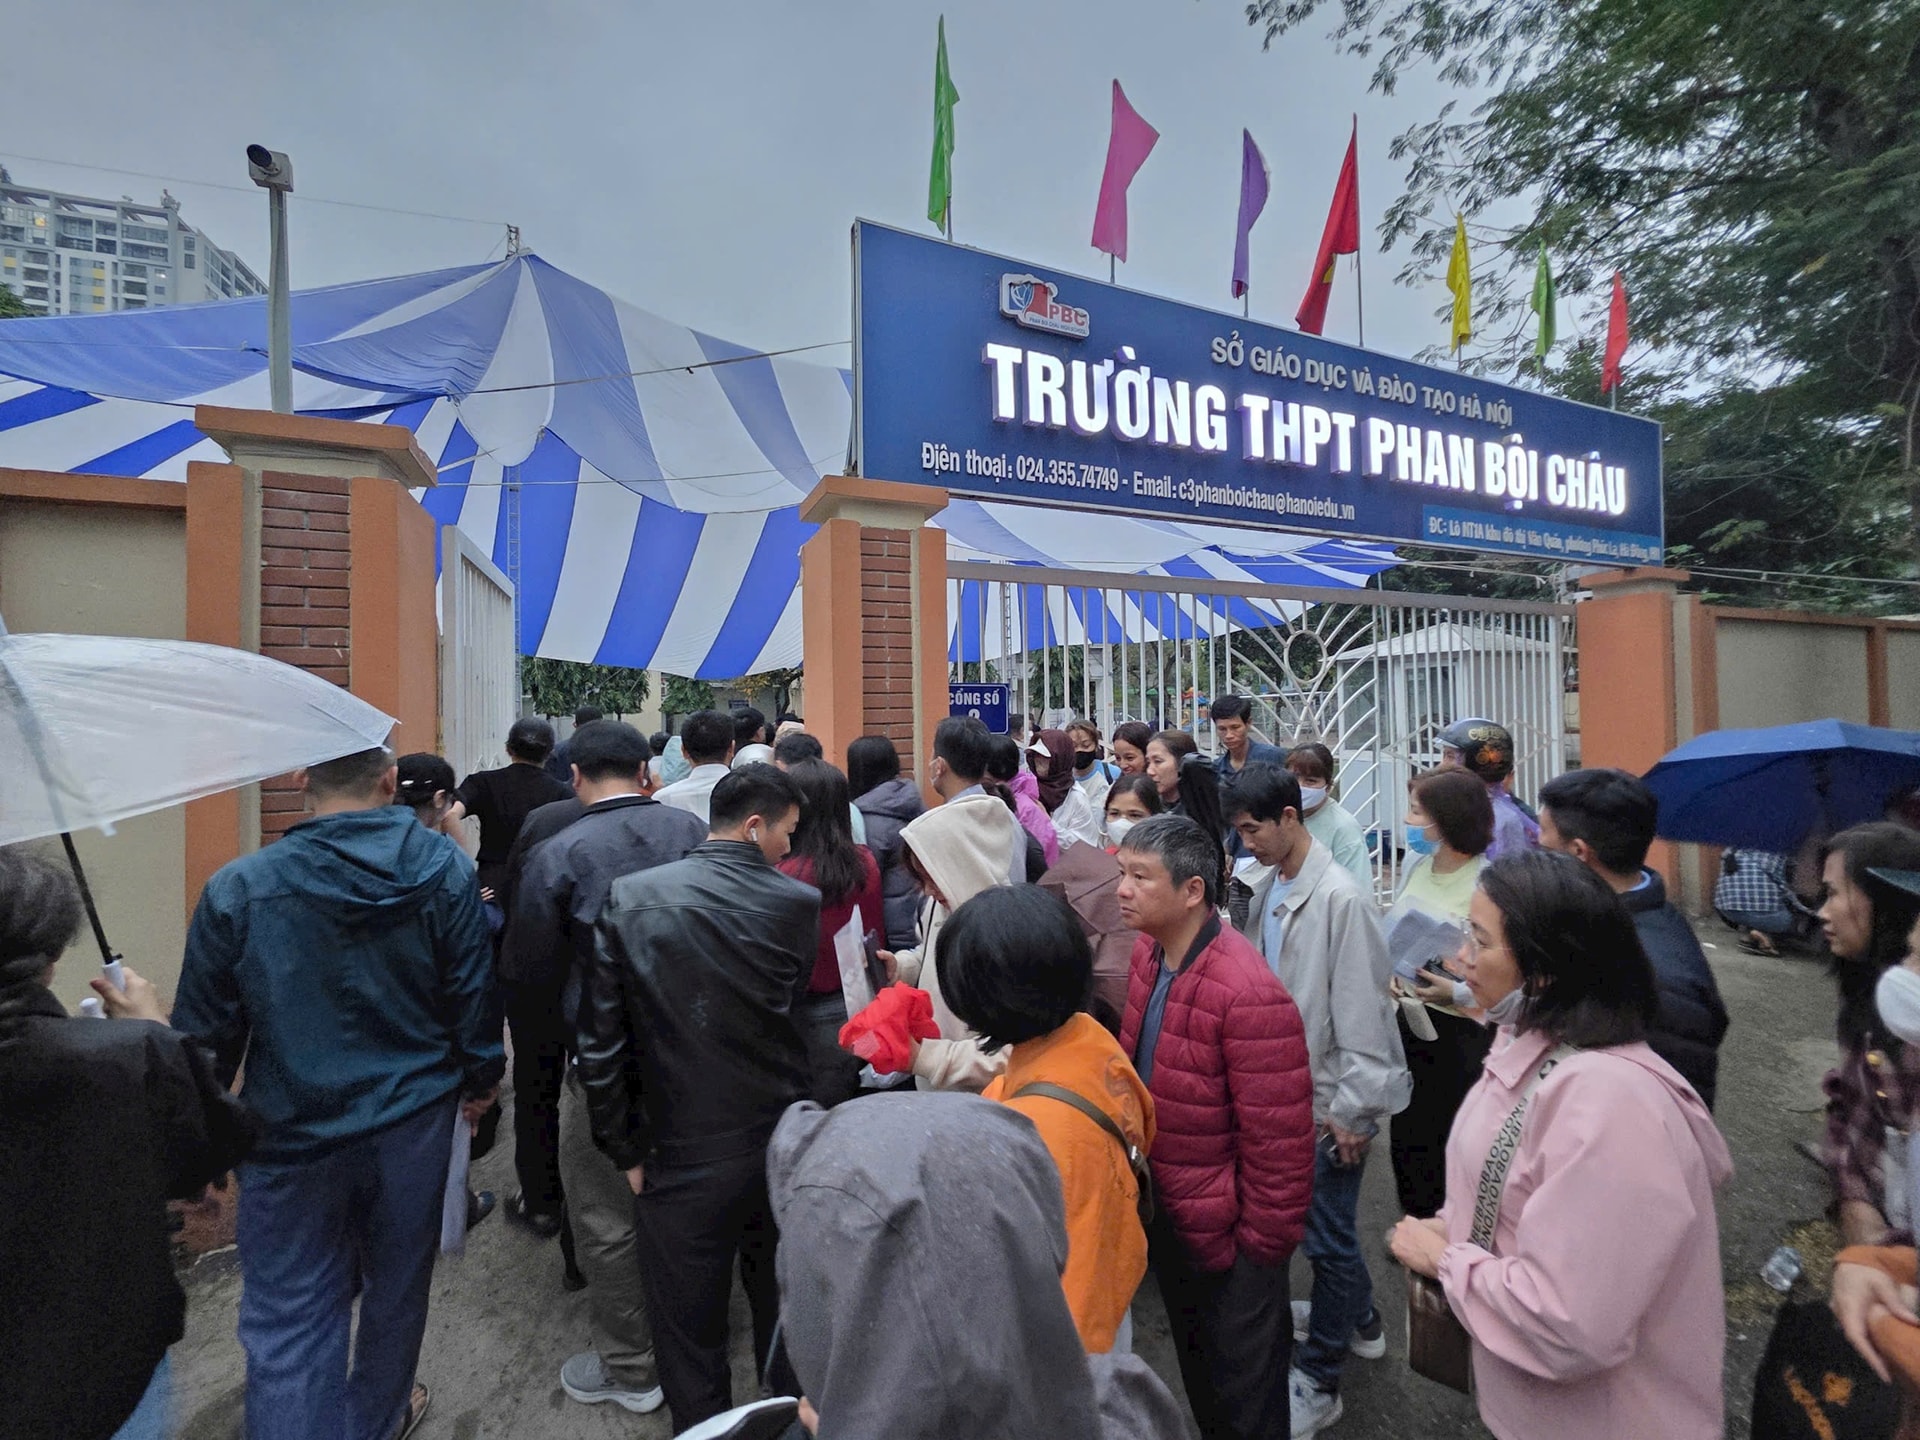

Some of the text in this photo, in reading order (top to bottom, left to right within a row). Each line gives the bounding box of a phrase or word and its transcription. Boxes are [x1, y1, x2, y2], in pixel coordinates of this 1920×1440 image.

[1049, 304, 1086, 327] PBC
[1211, 331, 1513, 428] SỞ GIÁO DỤC VÀ ĐÀO TẠO HÀ NỘI
[983, 342, 1626, 515] TRƯỜNG THPT PHAN BỘI CHÂU
[921, 442, 960, 475] Điện
[965, 449, 1013, 483] thoại:
[1016, 455, 1119, 491] 024.355.74749
[984, 688, 1000, 706] SỐ
